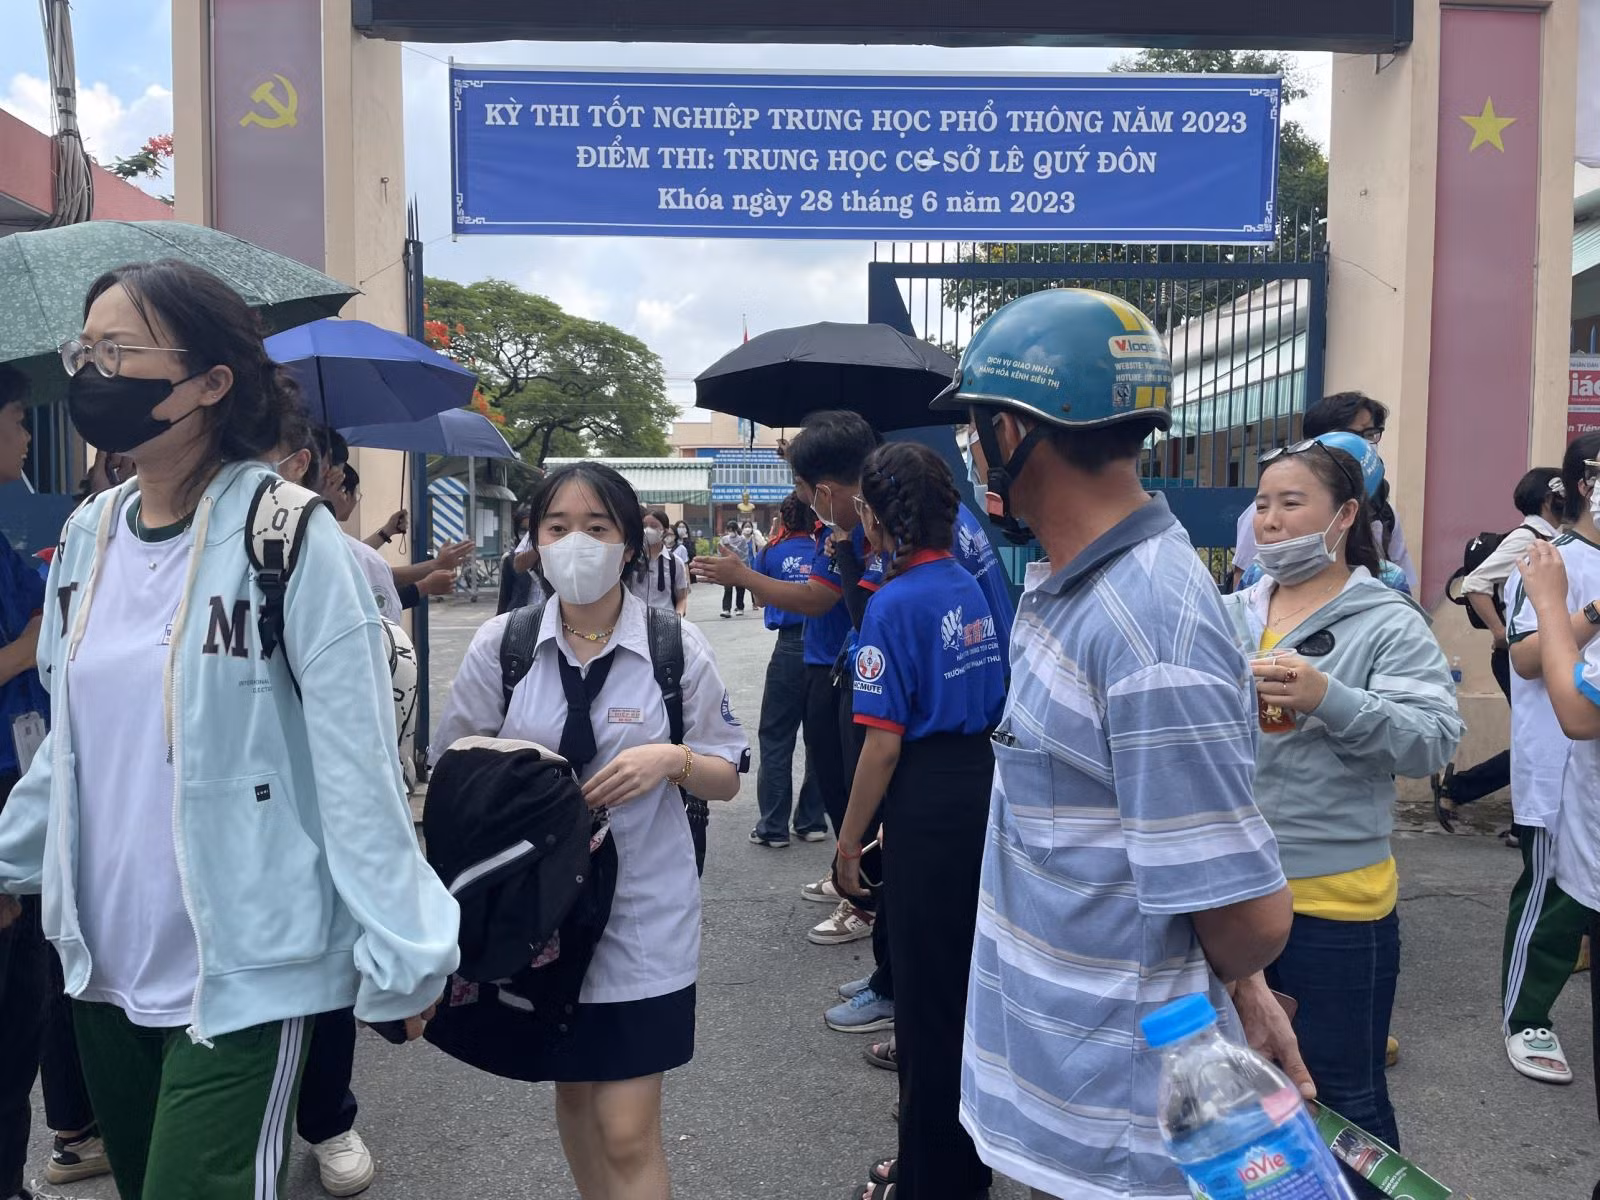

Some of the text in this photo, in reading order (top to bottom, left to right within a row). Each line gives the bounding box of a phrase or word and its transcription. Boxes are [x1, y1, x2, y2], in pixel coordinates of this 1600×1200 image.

[485, 94, 1248, 139] KỲ THI TỐT NGHIỆP TRUNG HỌC PHỔ THÔNG NĂM 2023
[576, 134, 1157, 179] ĐIỂM THI: TRUNG HỌC CƠ SỞ LÊ QUÝ ĐÔN
[658, 186, 1075, 219] Khóa ngày 28 tháng 6 năm 2023
[1012, 360, 1031, 370] GIAO
